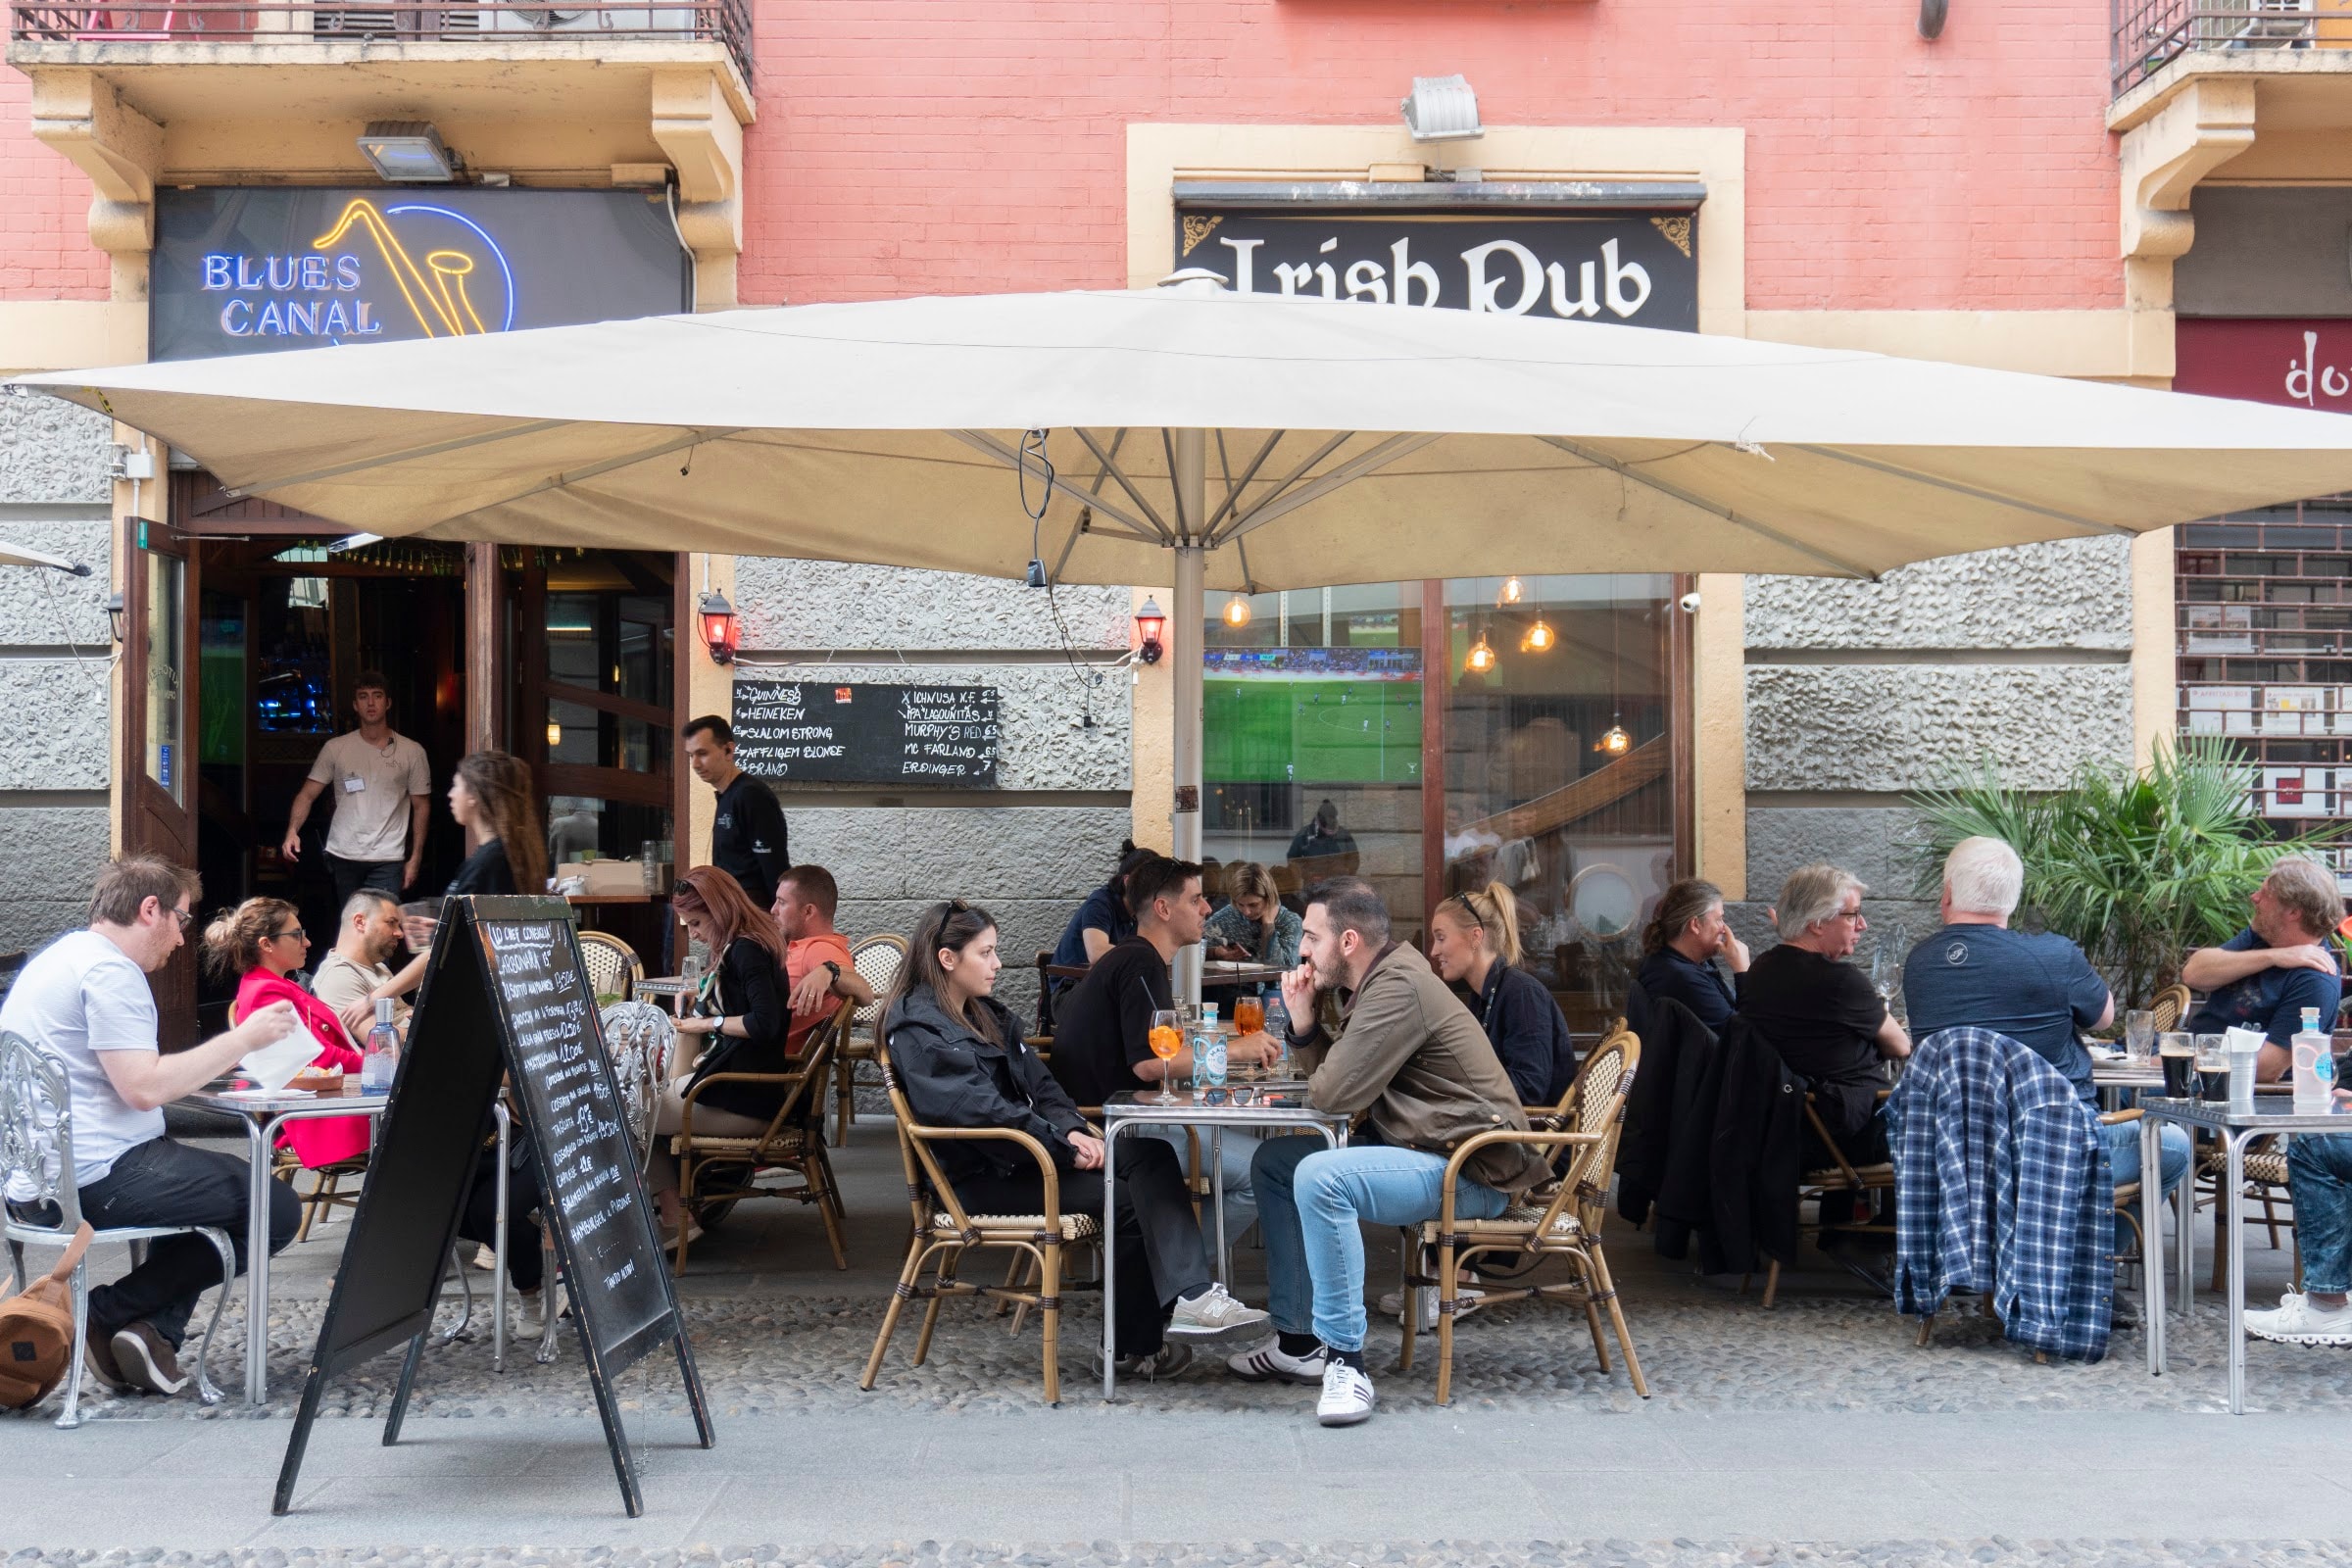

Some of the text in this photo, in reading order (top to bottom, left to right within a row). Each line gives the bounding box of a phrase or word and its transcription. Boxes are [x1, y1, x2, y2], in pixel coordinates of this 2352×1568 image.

[203, 255, 361, 291] BLUES
[1220, 236, 1652, 318] Irish Pub
[221, 298, 382, 336] CANAL
[2284, 330, 2352, 407] do
[749, 687, 802, 705] GUINNESS
[913, 691, 956, 705] ICHNUSA
[748, 707, 807, 721] HEINEKEN
[747, 727, 790, 740] SLALOM
[791, 726, 833, 741] STRONG
[905, 723, 960, 742] MURPHY'S
[963, 725, 982, 740] RED
[747, 746, 801, 760] AFFLIGEM
[924, 743, 976, 759] FARLAND
[747, 761, 788, 776] BRAND
[902, 760, 992, 777] ERDINGER 7
